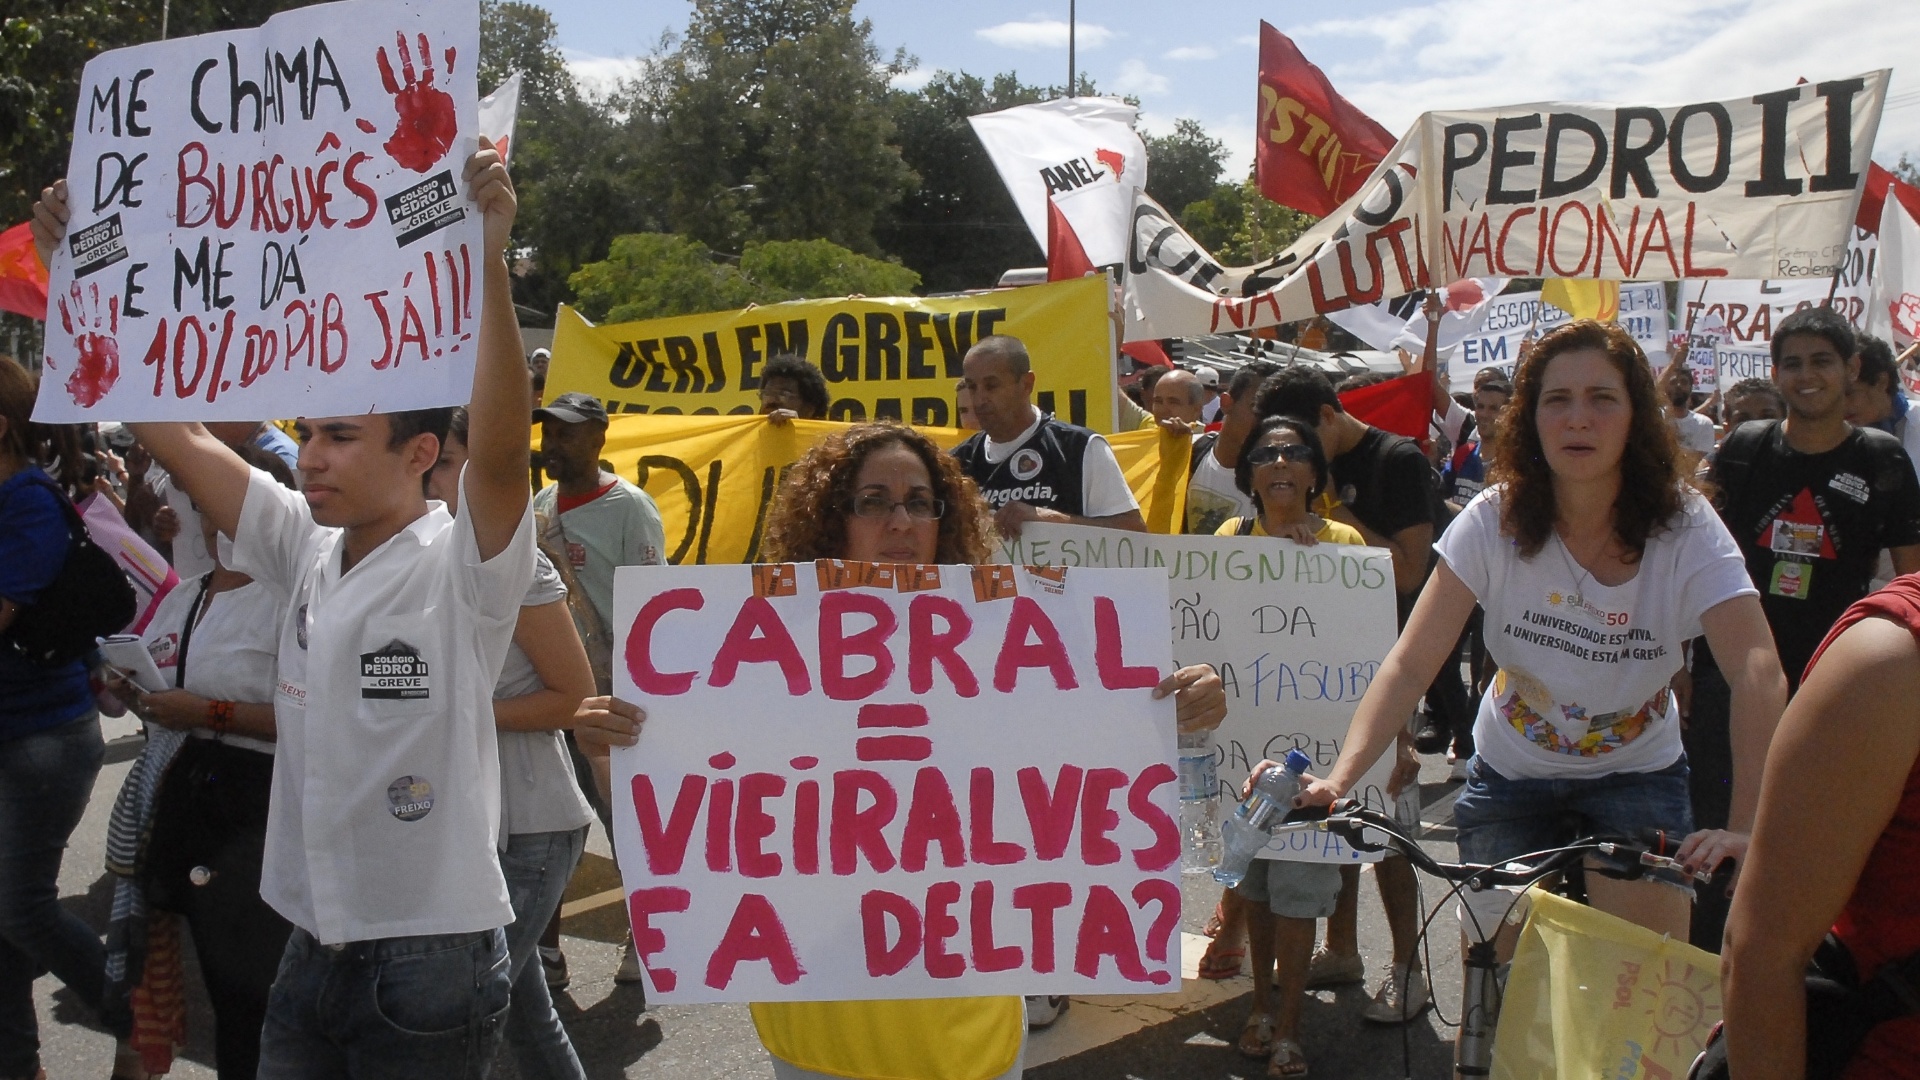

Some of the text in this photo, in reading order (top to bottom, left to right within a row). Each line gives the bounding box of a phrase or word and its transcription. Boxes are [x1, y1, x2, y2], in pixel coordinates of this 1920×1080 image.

[88, 68, 154, 137] ME
[1443, 78, 1863, 212] PEDRO II
[92, 131, 379, 233] DE BURGUÊS
[1039, 156, 1105, 196] ANEL
[391, 190, 439, 221] PEDRO
[441, 183, 453, 196] II
[410, 200, 452, 227] GREVE
[72, 224, 120, 255] PEDRO II
[87, 240, 119, 262] GREVE
[122, 234, 309, 318] E ME DÁ
[1210, 290, 1281, 333] NA
[1443, 201, 1728, 278] NACIONAL
[142, 309, 236, 403] 10%
[609, 331, 727, 394] UERJ
[1463, 336, 1508, 363] EM
[1143, 547, 1386, 590] INDIGNADOS
[1170, 592, 1317, 641] ÃO DA
[1522, 610, 1530, 621] A
[1532, 612, 1607, 645] UNIVERSIDADE
[1609, 633, 1627, 645] EST
[1607, 612, 1629, 626] 50
[374, 655, 415, 664] COLÉGIO
[625, 588, 1160, 700] CABRAL
[1504, 623, 1511, 635] A
[1513, 625, 1589, 660] UNIVERSIDADE
[1592, 649, 1618, 664] ESTÁ
[364, 663, 427, 675] PEDRO II
[378, 678, 421, 687] GREVE
[394, 801, 431, 815] FREIXO
[629, 878, 1182, 993] E A DELTA?
[1612, 961, 1641, 1010] PSOL
